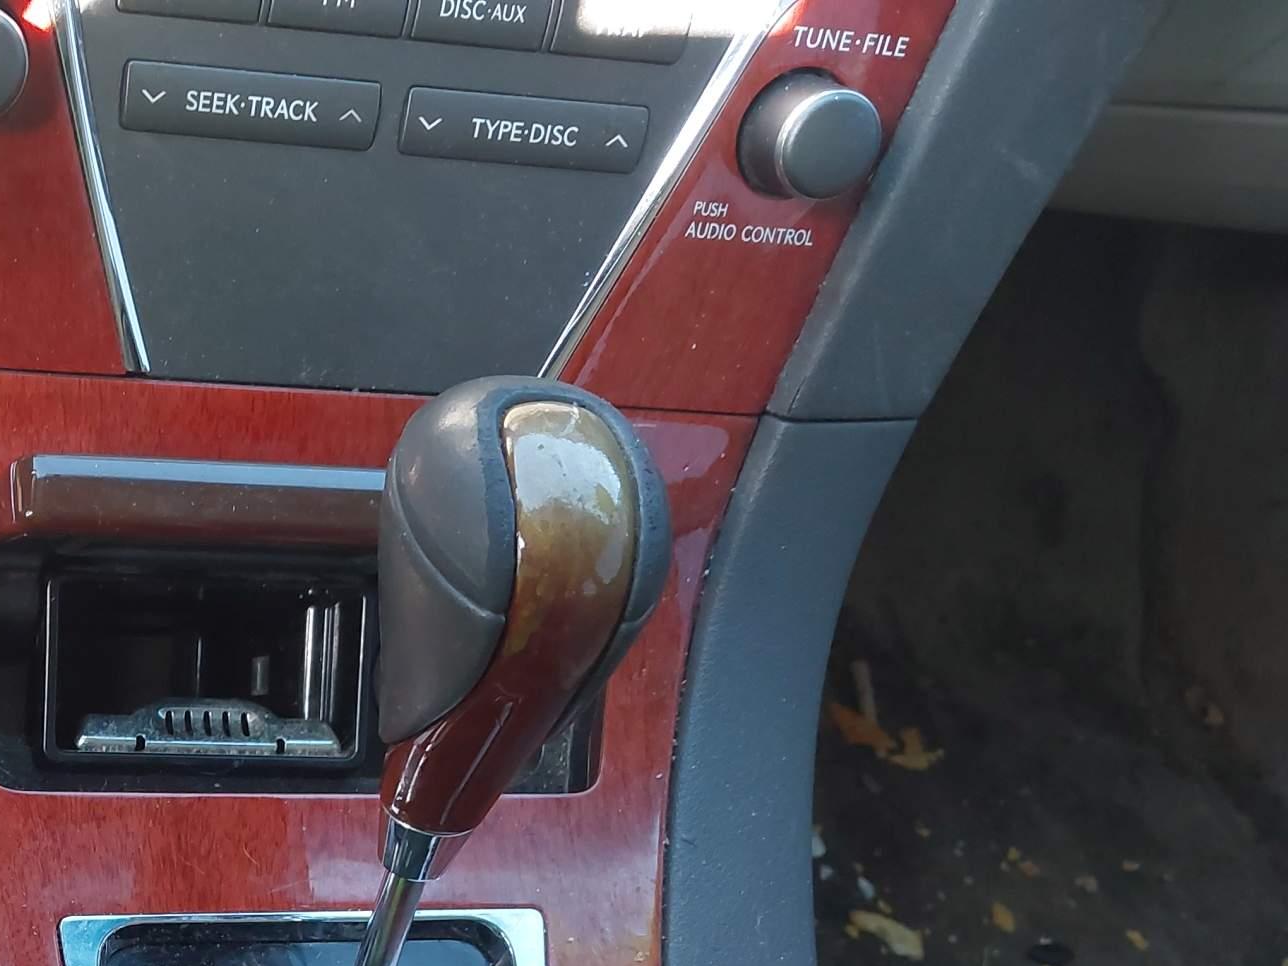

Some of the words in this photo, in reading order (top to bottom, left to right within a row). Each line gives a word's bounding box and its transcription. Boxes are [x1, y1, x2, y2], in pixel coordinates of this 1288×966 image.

[693, 200, 728, 218] PUSH
[684, 221, 737, 241] AUDIO
[741, 225, 813, 246] CONTROL
